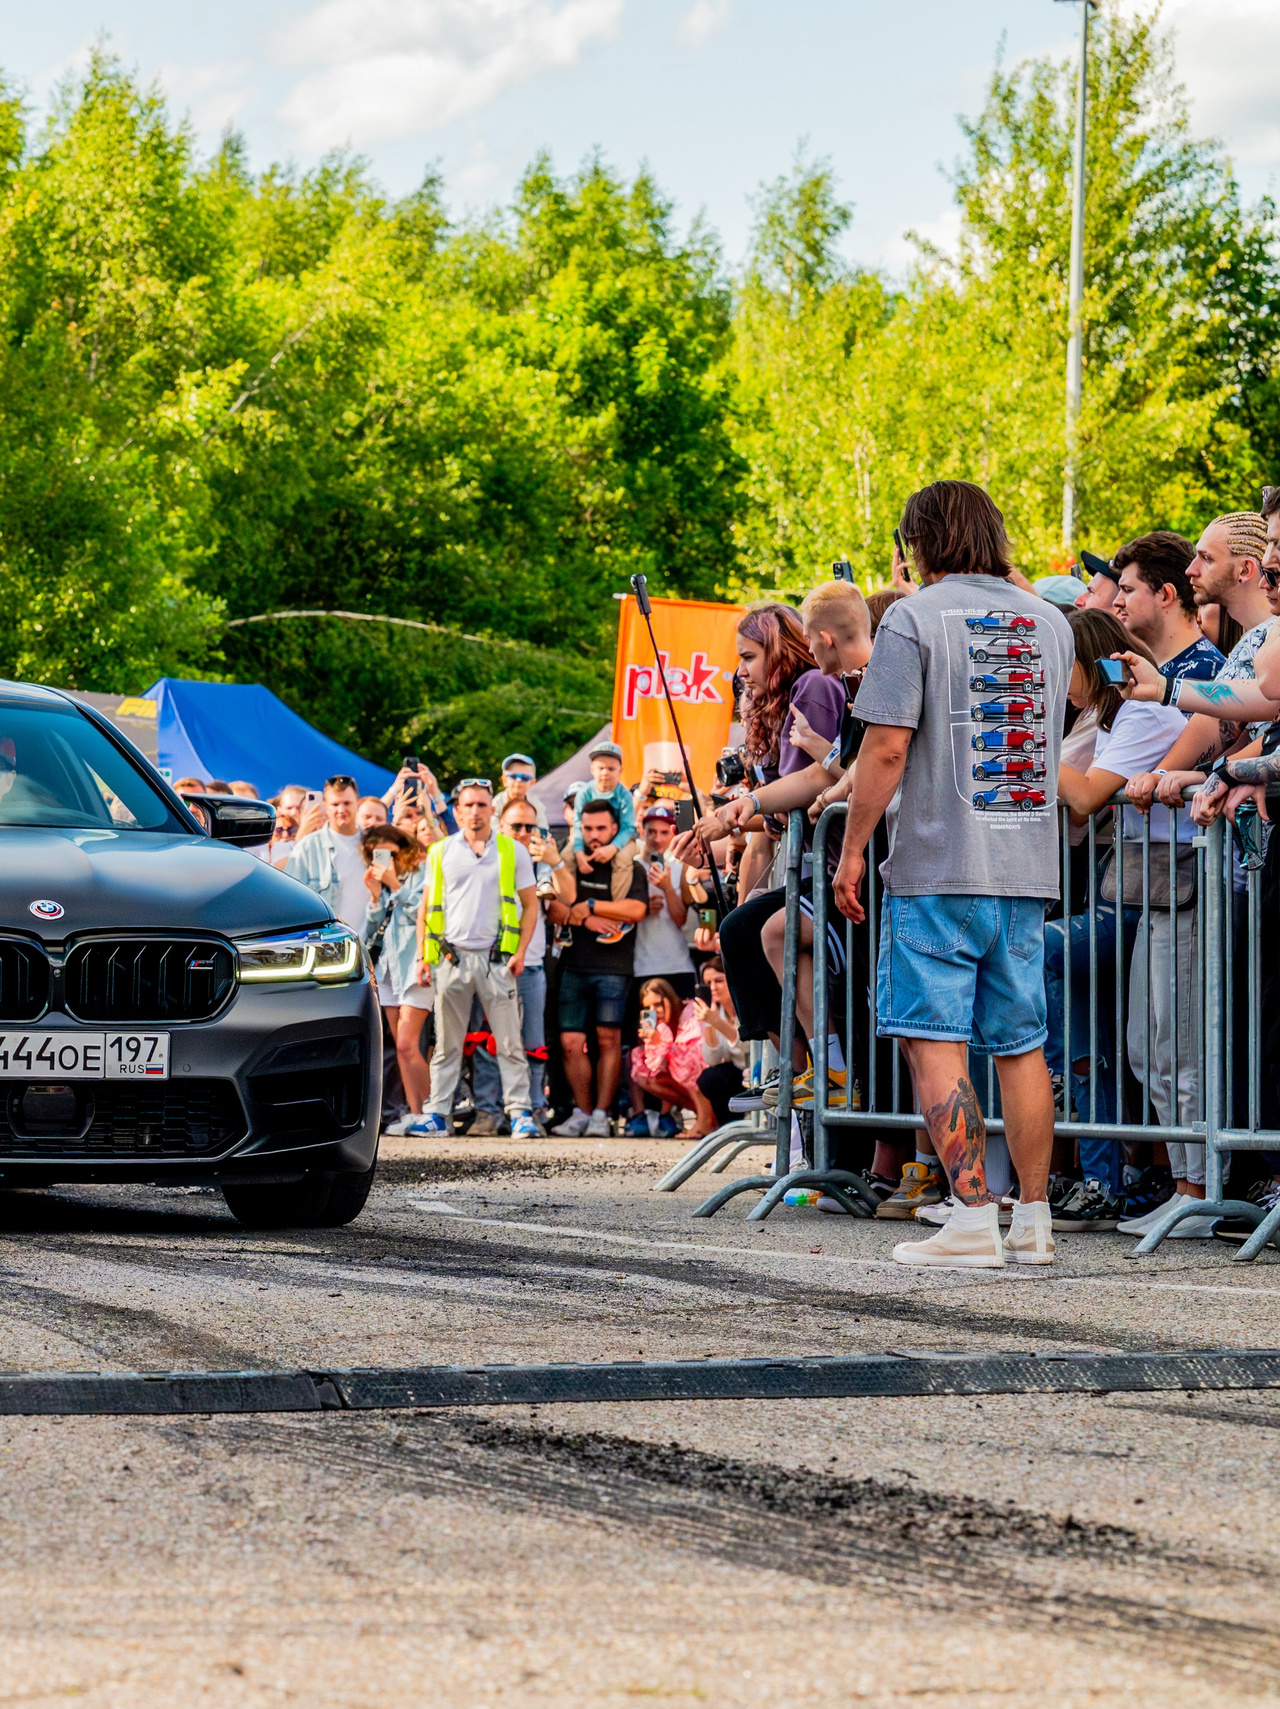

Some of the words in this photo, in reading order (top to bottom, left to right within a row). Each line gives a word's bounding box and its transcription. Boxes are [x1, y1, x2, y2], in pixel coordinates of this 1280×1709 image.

[623, 650, 724, 720] plak
[109, 1036, 159, 1062] 197
[120, 1063, 145, 1074] RUS
